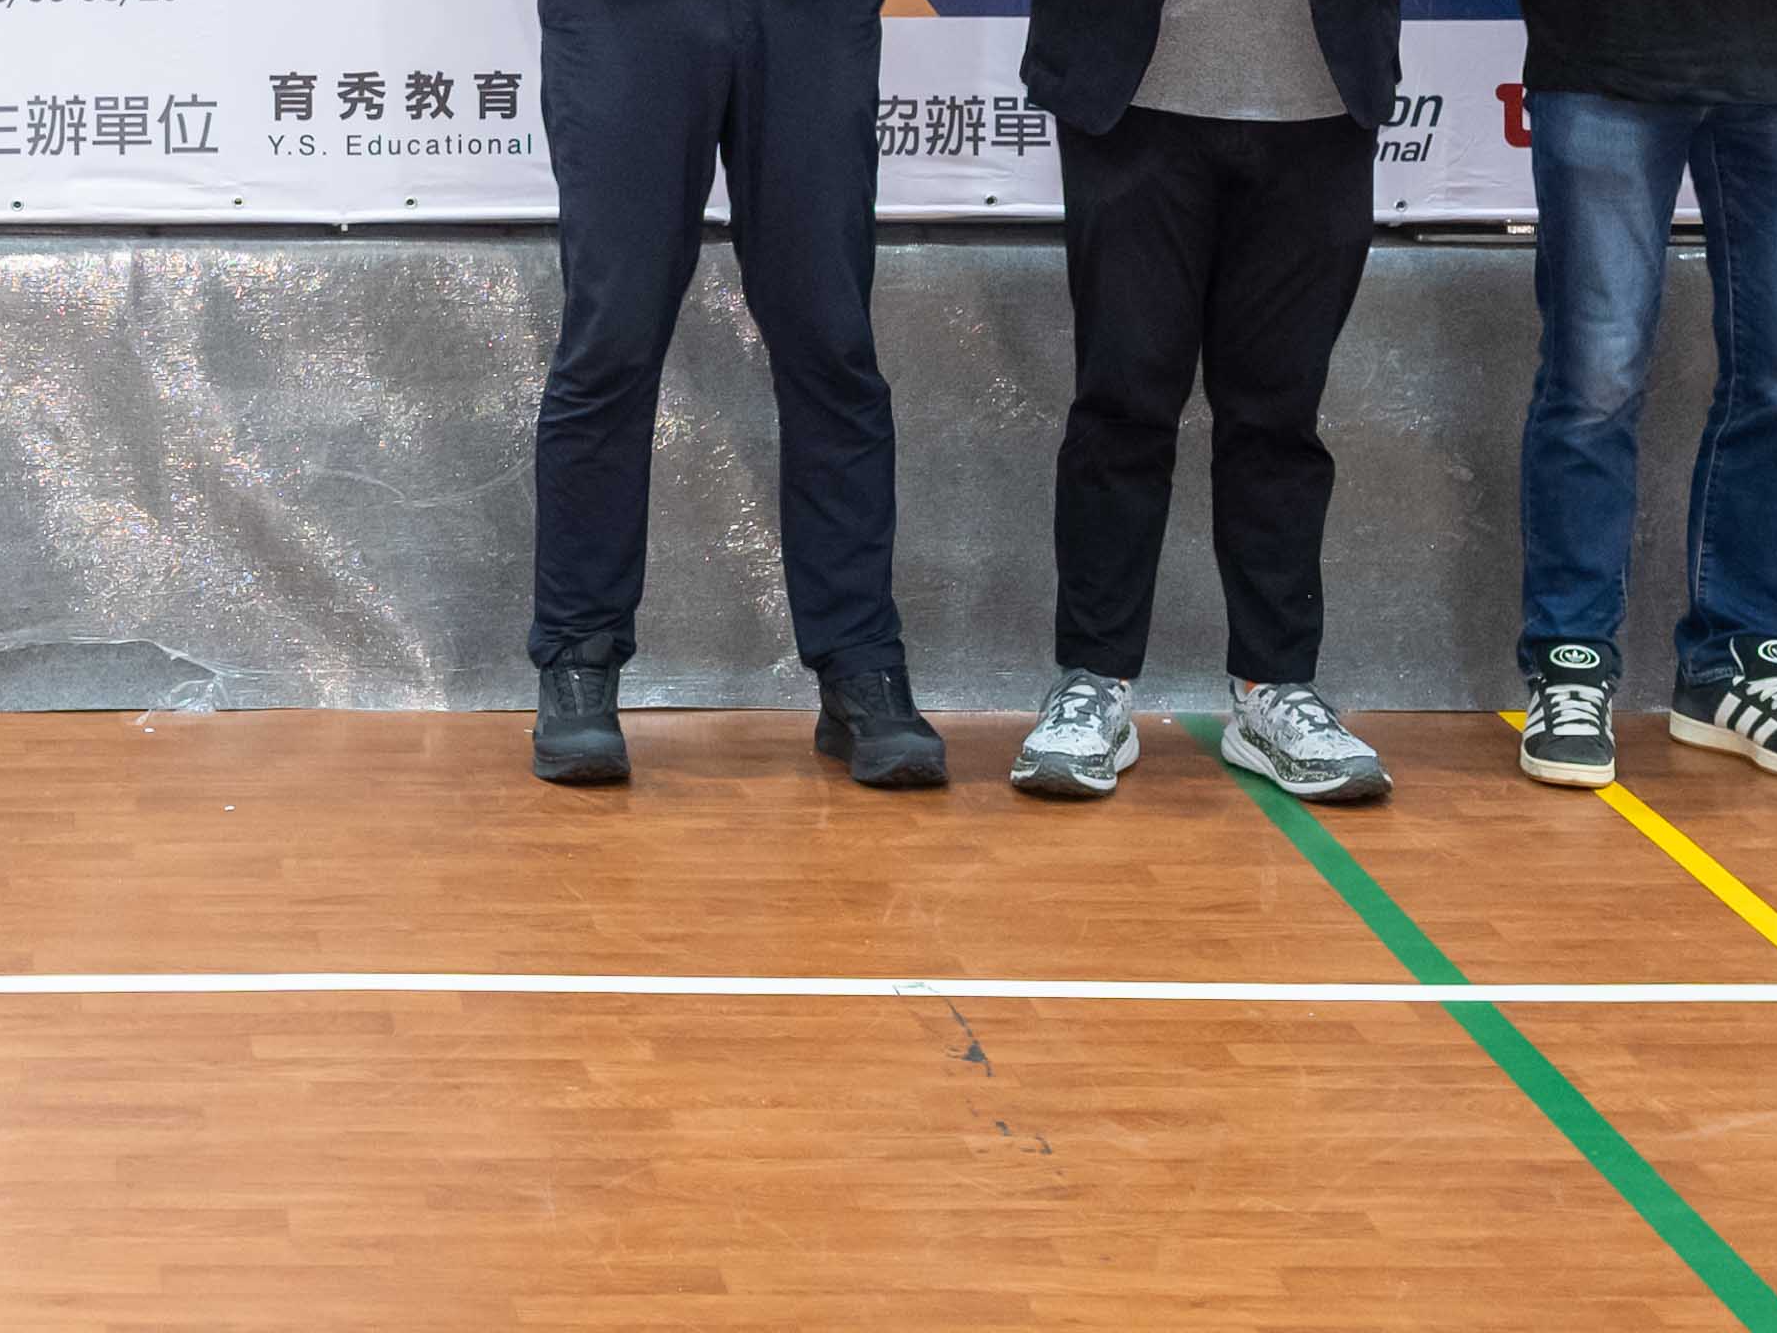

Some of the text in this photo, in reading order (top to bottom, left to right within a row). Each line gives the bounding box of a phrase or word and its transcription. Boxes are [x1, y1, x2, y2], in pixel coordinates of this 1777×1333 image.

[269, 70, 523, 123] 育秀教育
[269, 134, 533, 157] Y.S. Educational
[1378, 134, 1433, 162] nal
